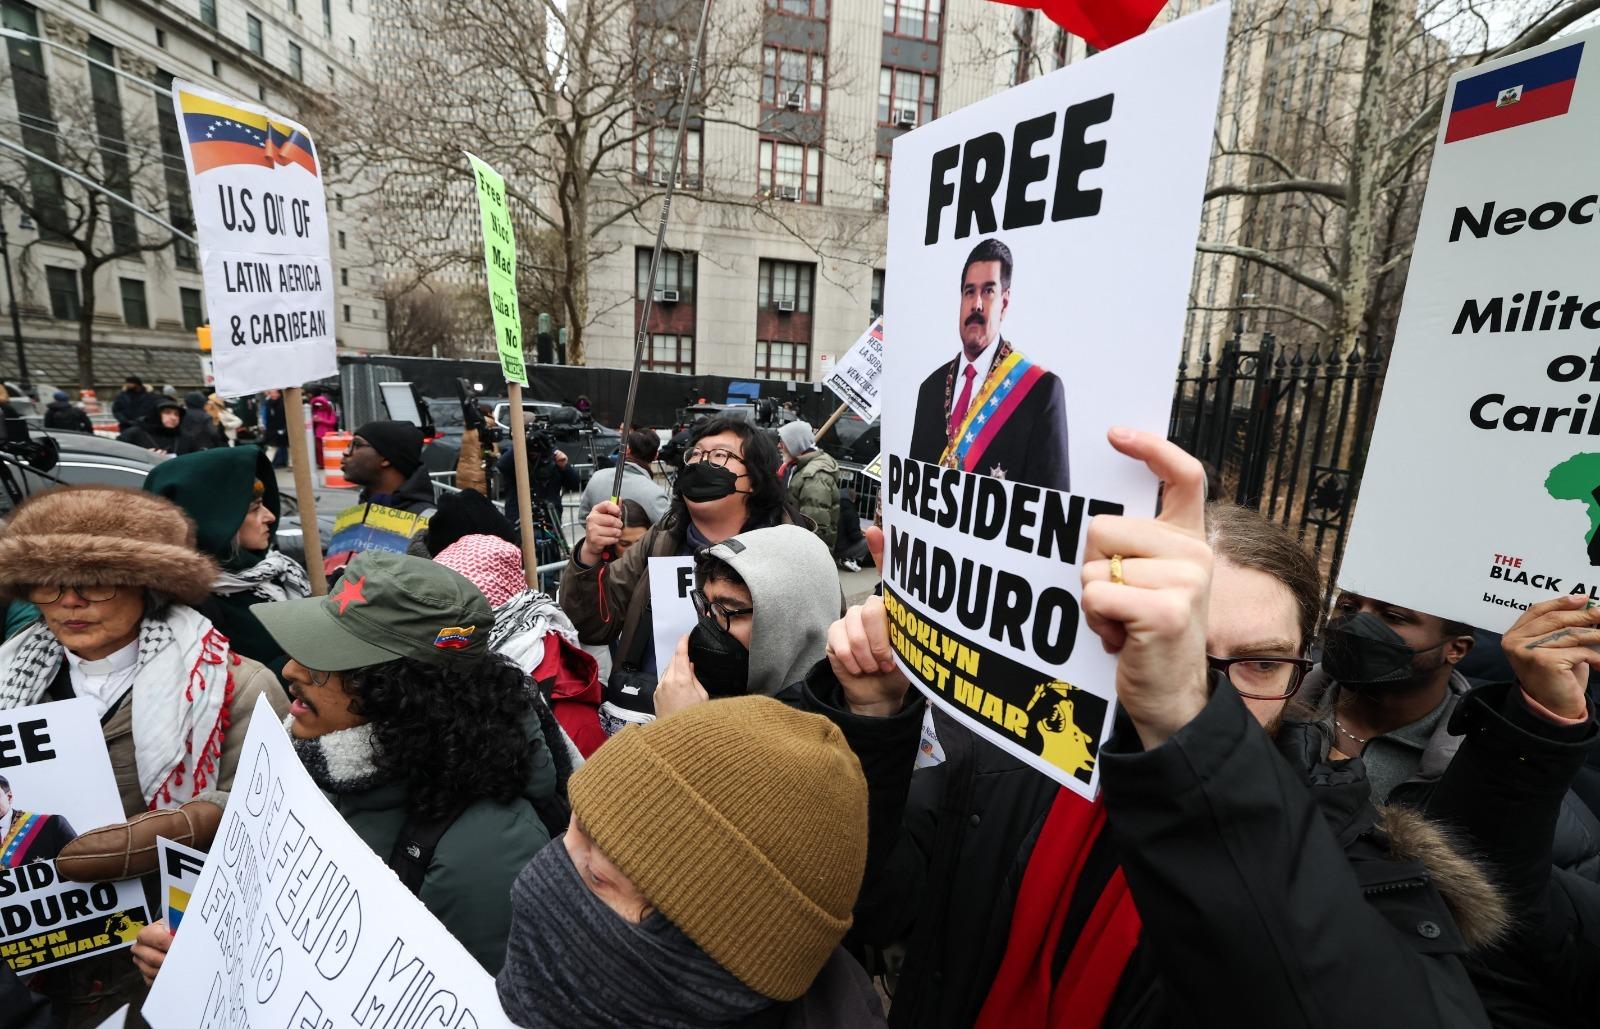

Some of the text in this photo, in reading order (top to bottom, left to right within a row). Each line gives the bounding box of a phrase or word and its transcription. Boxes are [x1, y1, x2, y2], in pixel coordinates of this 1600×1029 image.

[925, 92, 1115, 246] FREE
[478, 170, 502, 208] Free
[218, 184, 256, 233] U.S
[292, 197, 310, 238] OF
[1449, 194, 1600, 242] Neoc
[223, 260, 322, 293] LATIN AERICA
[230, 315, 246, 346] &
[847, 366, 878, 398] VENEZUELA
[866, 368, 877, 380] DE
[387, 509, 414, 521] CILIA
[1489, 565, 1563, 592] BLACK
[1494, 553, 1523, 569] THE
[890, 524, 1080, 666] MADURO
[884, 587, 981, 678] BROOKLYN
[886, 618, 951, 693] GAINST
[953, 674, 1030, 739] WAR
[0, 859, 67, 898] SID
[0, 882, 118, 938] DURO
[51, 933, 113, 958] WAR
[351, 936, 478, 1029] MI
